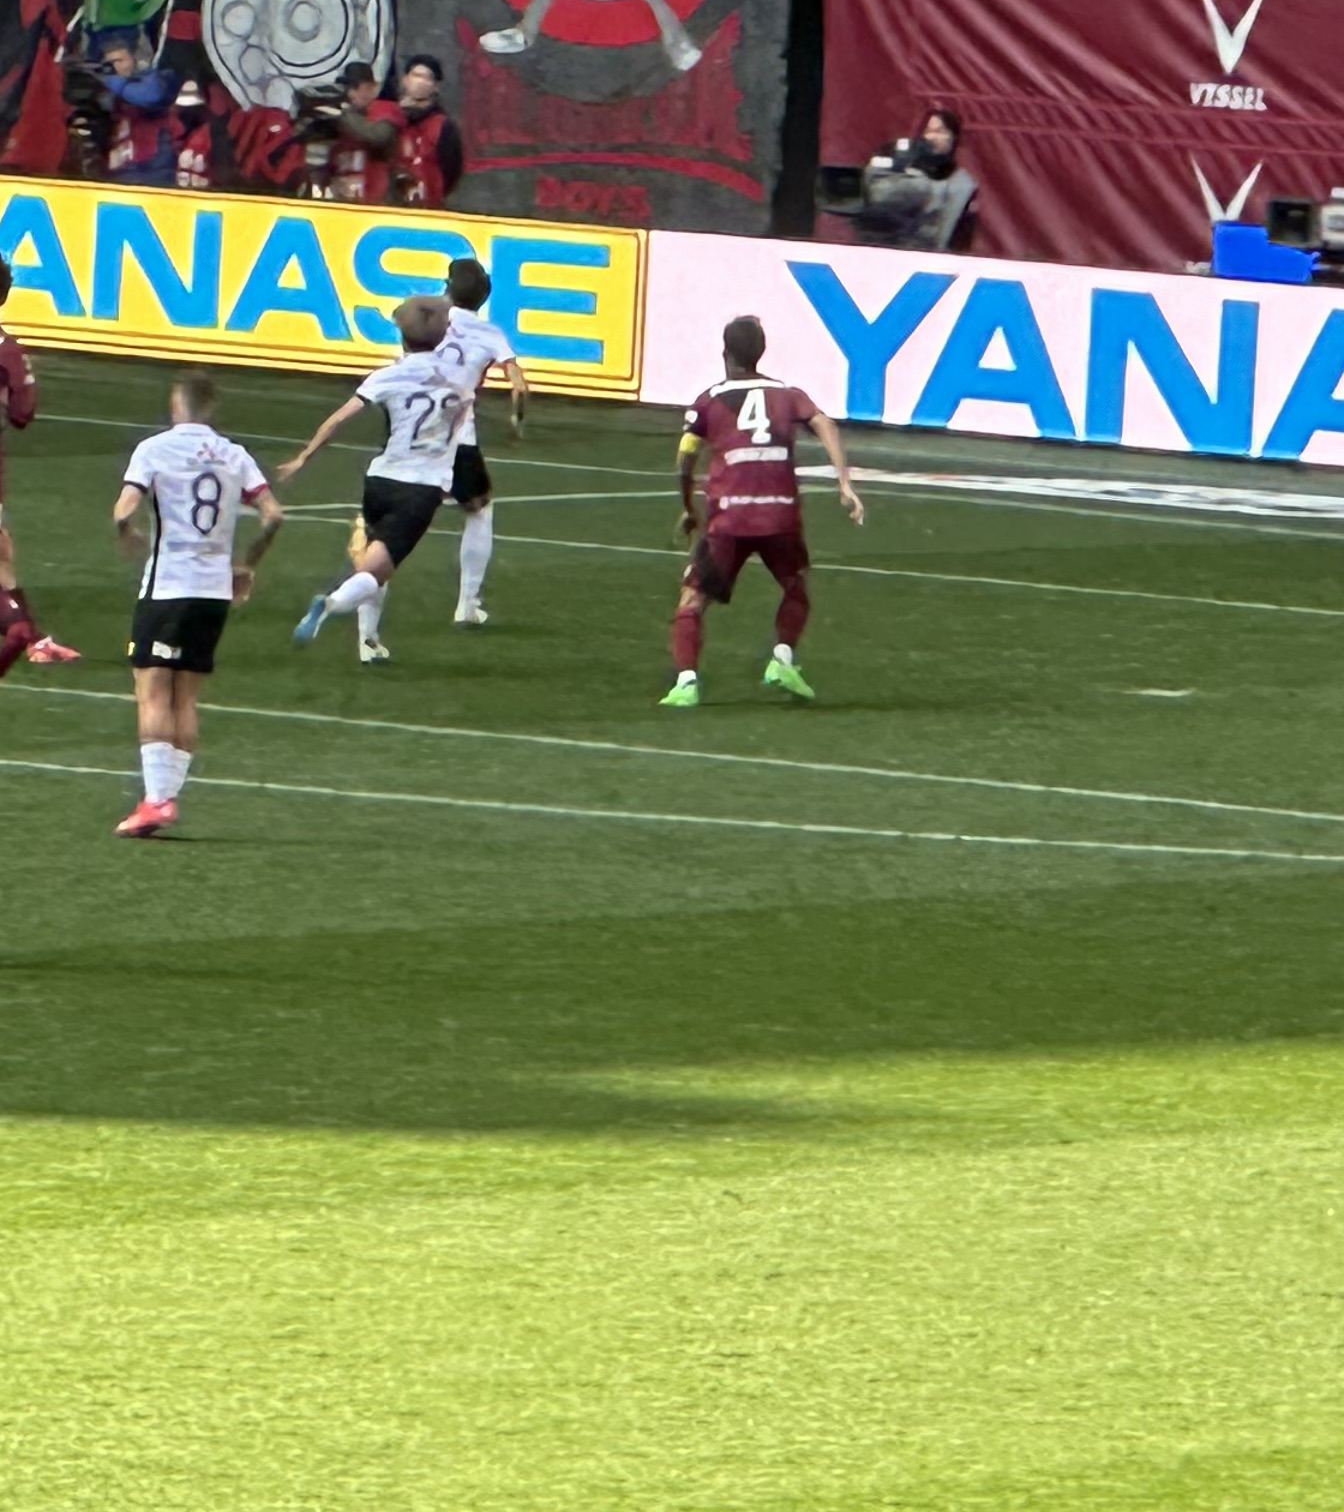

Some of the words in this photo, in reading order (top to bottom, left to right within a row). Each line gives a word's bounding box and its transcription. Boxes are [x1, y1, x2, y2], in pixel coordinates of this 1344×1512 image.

[1189, 82, 1268, 111] VISSEL
[736, 387, 773, 445] 4
[191, 471, 222, 536] 8
